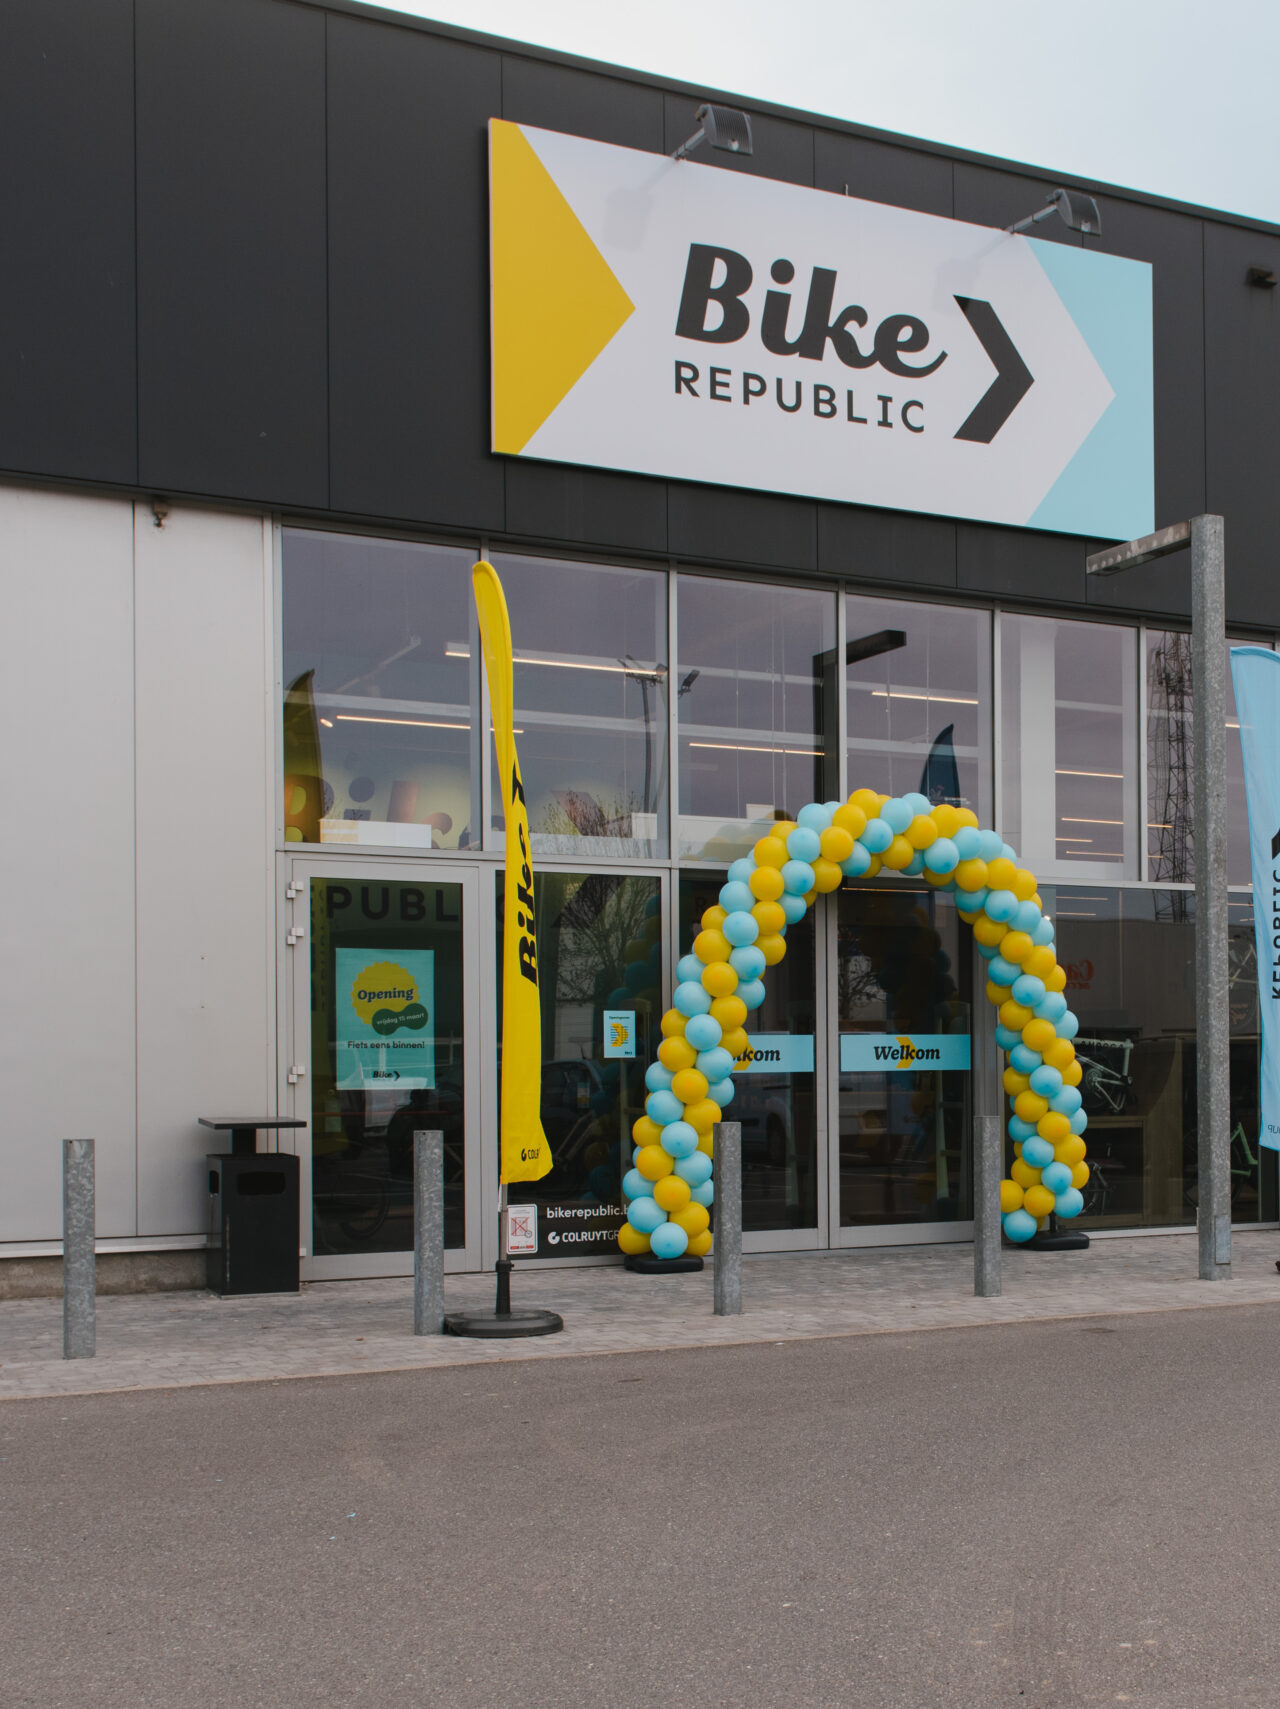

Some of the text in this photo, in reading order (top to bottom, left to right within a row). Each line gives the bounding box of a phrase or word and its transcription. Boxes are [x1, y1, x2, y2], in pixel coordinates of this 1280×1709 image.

[674, 242, 948, 379] Bike
[674, 360, 925, 433] REPUBLIC
[516, 822, 538, 987] Bike
[357, 987, 414, 1003] Opening
[347, 1040, 368, 1049] Fiets
[392, 1040, 425, 1049] binnen!
[733, 1047, 781, 1062] kom
[873, 1045, 941, 1062] Welkom
